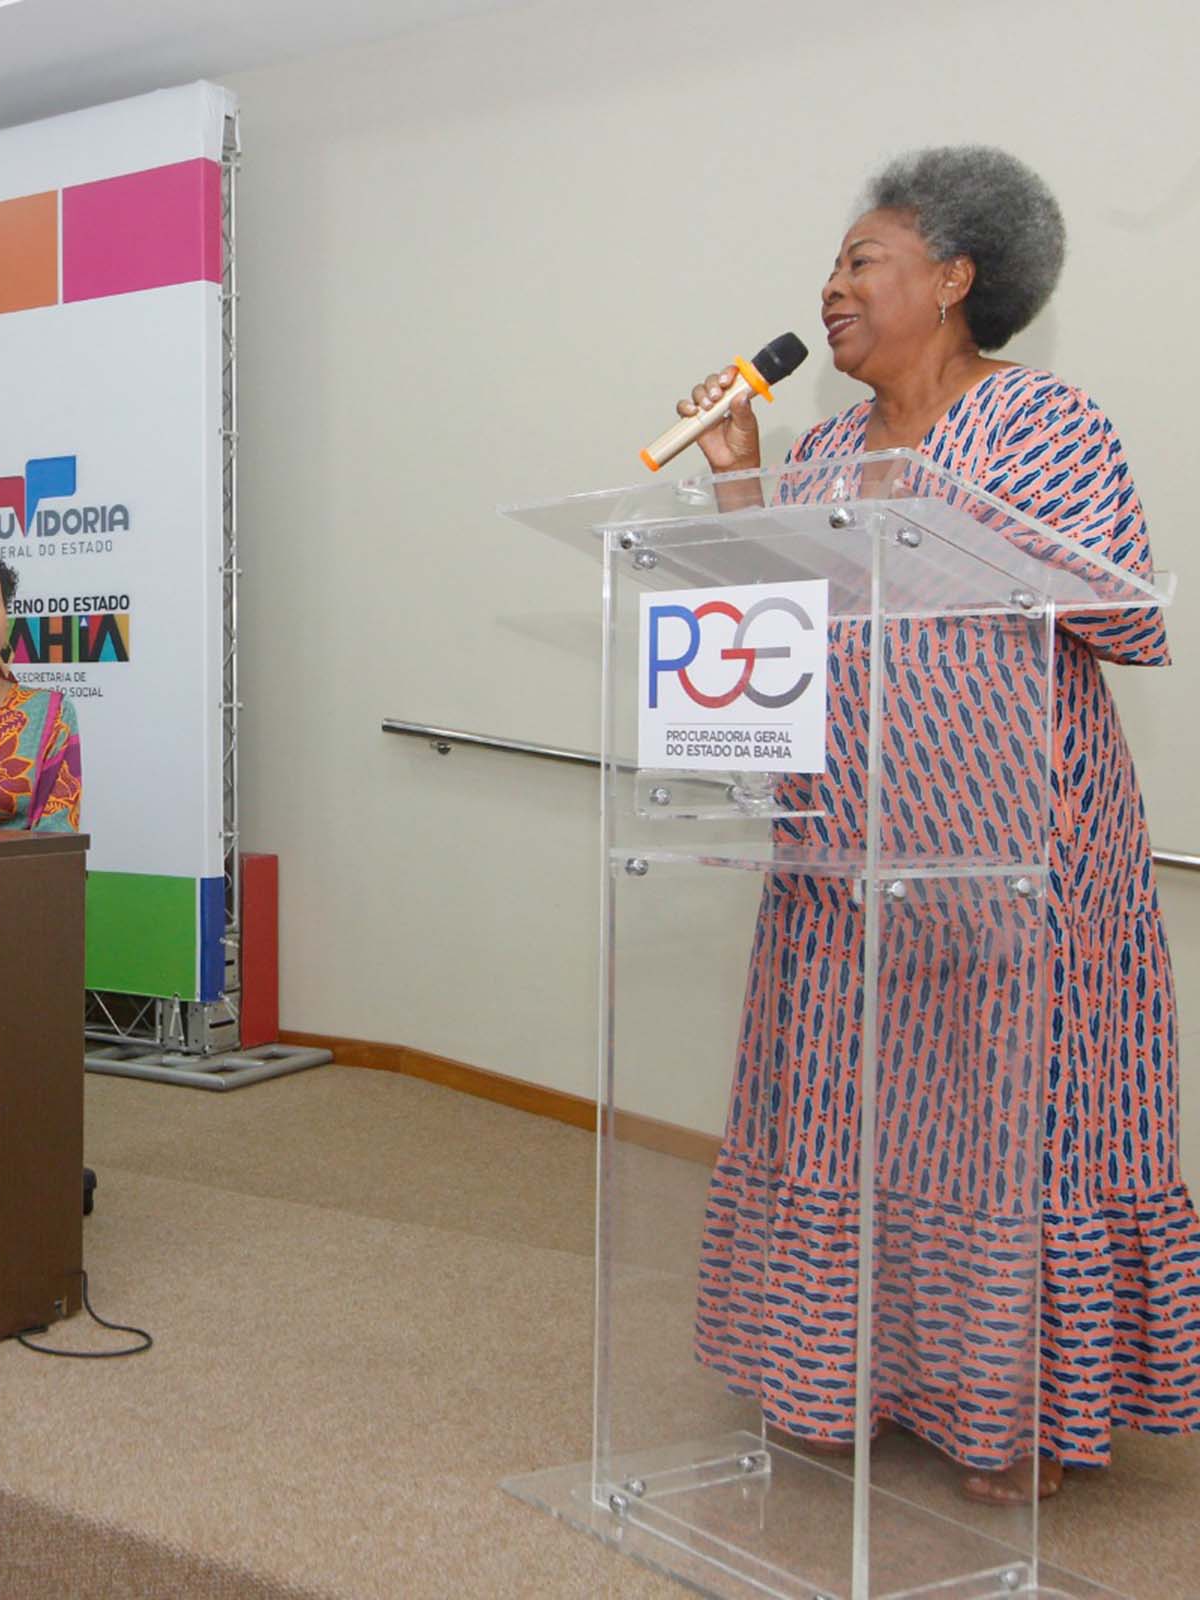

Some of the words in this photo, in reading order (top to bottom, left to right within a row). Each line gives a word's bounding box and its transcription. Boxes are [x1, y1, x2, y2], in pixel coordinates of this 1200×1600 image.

[39, 543, 56, 557] DO
[61, 539, 113, 555] ESTADO
[6, 598, 44, 615] ERNO
[48, 597, 69, 613] DO
[73, 594, 130, 612] ESTADO
[7, 613, 130, 664] AHIA
[648, 597, 815, 709] PGE
[16, 672, 72, 683] SECRETARIA
[73, 671, 87, 682] DE
[69, 686, 104, 698] SOCIAL
[666, 730, 752, 743] PROCURADORIA
[753, 731, 792, 743] GERAL
[665, 744, 684, 757] DO
[686, 744, 732, 758] ESTADO
[734, 745, 751, 759] DA
[753, 745, 792, 759] BAHIA
